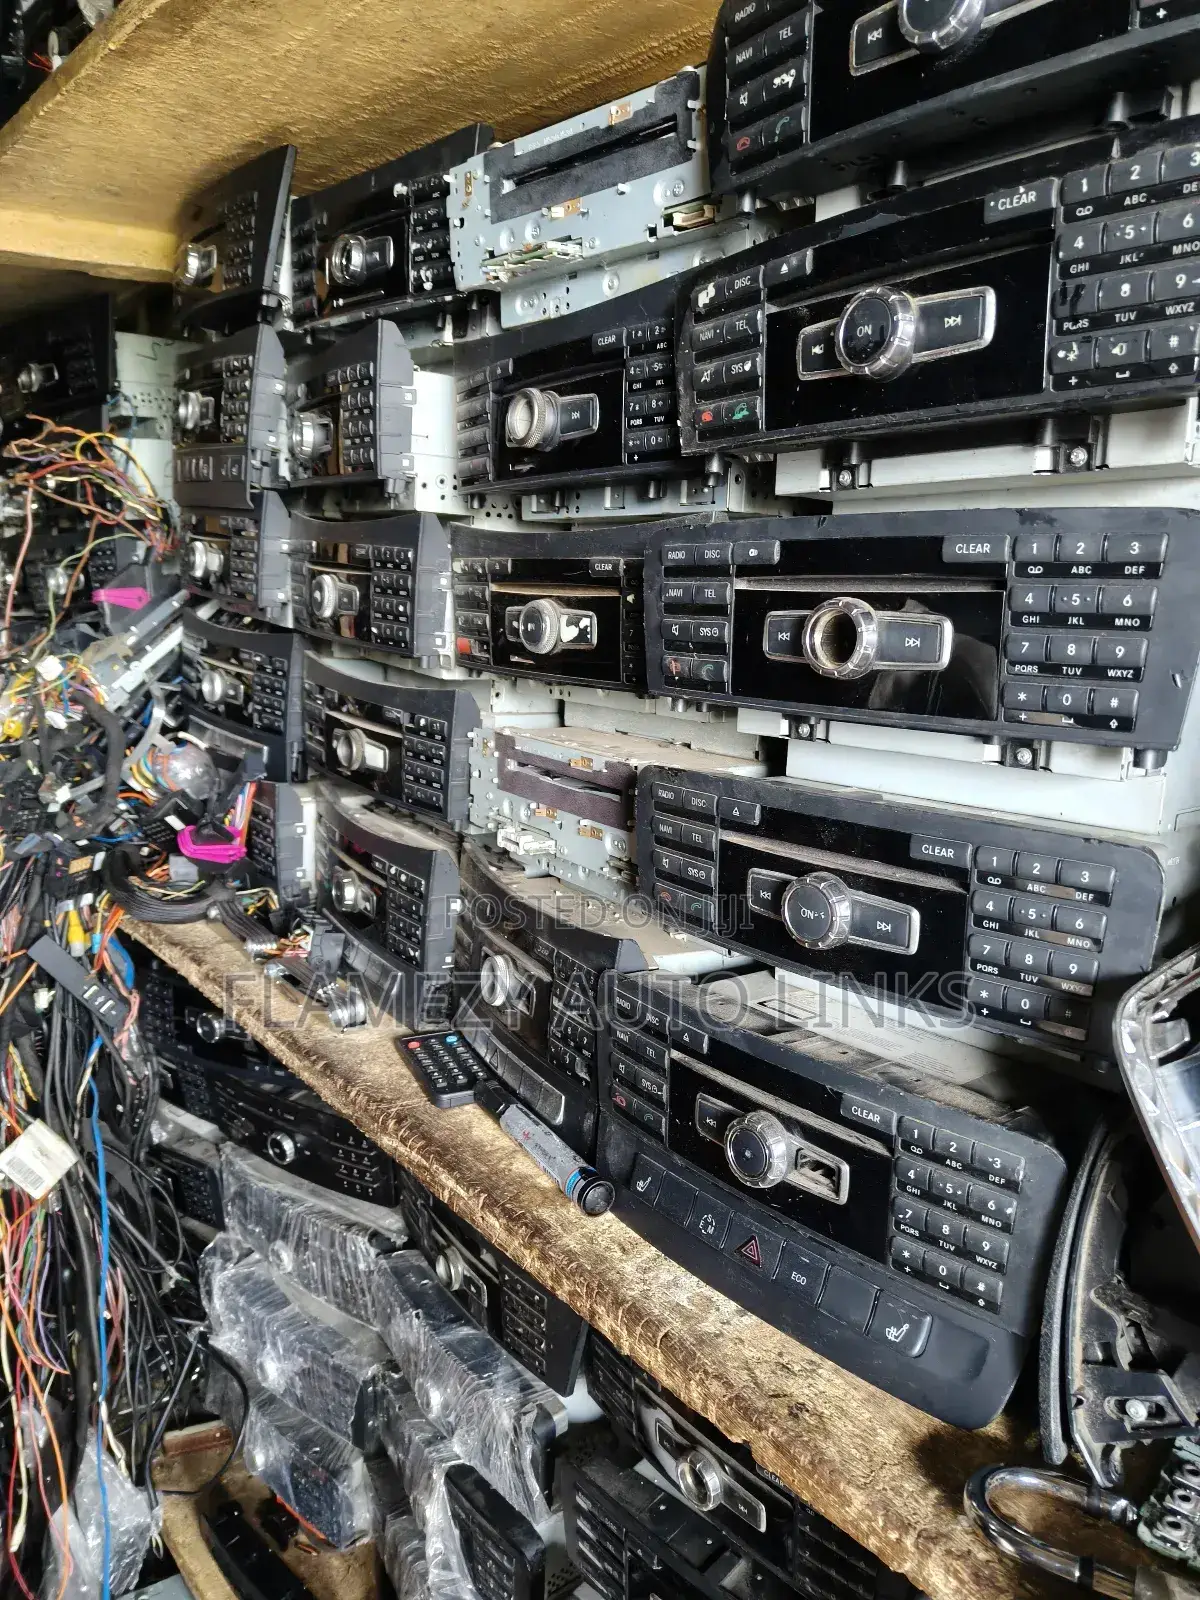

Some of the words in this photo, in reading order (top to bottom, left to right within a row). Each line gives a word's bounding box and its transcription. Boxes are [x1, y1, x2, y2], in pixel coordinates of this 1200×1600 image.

[735, 3, 756, 22] RADIO
[779, 26, 793, 40] TEL
[736, 47, 753, 64] NAVI
[1129, 165, 1141, 181] 2
[1081, 178, 1088, 192] 1
[998, 191, 1036, 211] CLEAR
[1124, 193, 1147, 206] ABC
[1183, 213, 1194, 228] 6
[1124, 225, 1134, 239] 5
[1074, 235, 1084, 249] 4
[1172, 241, 1200, 255] MNO
[1119, 253, 1138, 264] JKL
[1069, 262, 1090, 274] GHI
[734, 275, 751, 289] DISC
[1175, 274, 1187, 288] 9
[1120, 283, 1131, 297] 8
[1165, 302, 1195, 315] WXYZ
[1114, 311, 1137, 323] TUV
[654, 326, 660, 335] 2
[736, 321, 747, 332] TEL
[857, 324, 872, 337] ON
[597, 335, 616, 346] CLEAR
[700, 330, 714, 341] NAVI
[656, 342, 668, 350] ABC
[629, 366, 635, 375] 4
[731, 363, 743, 374] SYS
[629, 403, 634, 411] 7
[651, 399, 657, 409] 8
[650, 436, 656, 445] 0
[956, 543, 991, 554] CLEAR
[1032, 543, 1038, 554] 1
[1076, 543, 1085, 555] 2
[1130, 542, 1140, 555] 3
[668, 550, 686, 560] RADIO
[704, 550, 721, 559] DISC
[1071, 565, 1092, 575] ABC
[1124, 566, 1146, 575] DEF
[669, 588, 683, 598] NAVI
[704, 589, 716, 598] TEL
[1024, 592, 1034, 605] 4
[1071, 594, 1081, 606] 5
[1123, 594, 1133, 607] 6
[1022, 615, 1040, 624] GHI
[1067, 616, 1085, 626] JKL
[1115, 618, 1141, 627] MNO
[700, 628, 711, 637] SYS
[1021, 642, 1030, 654] 7
[1067, 643, 1076, 656] 8
[1115, 646, 1125, 658] 9
[1015, 664, 1039, 673] PQRS
[1062, 666, 1083, 675] TUV
[1107, 669, 1134, 679] WXYZ
[1062, 694, 1072, 705] 0
[658, 789, 675, 800] RADIO
[691, 797, 707, 808] DISC
[659, 824, 673, 834] NAVI
[692, 832, 703, 843] TEL
[922, 844, 955, 859] CLEAR
[992, 857, 997, 867] 1
[687, 867, 699, 877] SYS
[1032, 863, 1041, 875] 2
[1080, 871, 1090, 883] 3
[1027, 884, 1047, 894] ABC
[1075, 892, 1095, 901] DEF
[985, 900, 994, 911] 4
[800, 908, 814, 919] ON
[1028, 909, 1037, 919] 5
[982, 919, 999, 930] GHI
[1075, 918, 1084, 930] 6
[1024, 928, 1040, 939] JKL
[1067, 937, 1091, 948] MNO
[983, 945, 991, 955] 7
[1024, 953, 1033, 965] 8
[976, 963, 999, 975] PQRS
[1069, 963, 1077, 975] 9
[1020, 973, 1039, 984] TUV
[616, 997, 631, 1010] RADIO
[1021, 999, 1030, 1010] 0
[646, 1013, 660, 1026] DISC
[616, 1030, 629, 1043] NAVI
[646, 1047, 656, 1059] TEL
[641, 1079, 652, 1090] SYS
[851, 1106, 880, 1124] CLEAR
[913, 1129, 919, 1139] 1
[950, 1142, 957, 1153] 2
[945, 1158, 963, 1170] ABC
[993, 1158, 1001, 1169] 3
[908, 1169, 916, 1180] 4
[988, 1174, 1006, 1185] DEF
[906, 1185, 921, 1196] GHI
[945, 1184, 953, 1194] 5
[943, 1200, 957, 1211] JKL
[988, 1200, 996, 1211] 6
[706, 1214, 713, 1223] S
[905, 1209, 913, 1219] 7
[699, 1220, 706, 1229] E
[981, 1215, 1002, 1228] MNO
[706, 1225, 715, 1235] M
[900, 1224, 919, 1237] PQRS
[942, 1224, 950, 1235] 8
[938, 1240, 955, 1251] TUV
[982, 1241, 990, 1251] 9
[975, 1255, 998, 1269] WXYZ
[939, 1265, 947, 1276] 0
[791, 1271, 807, 1286] ECO
